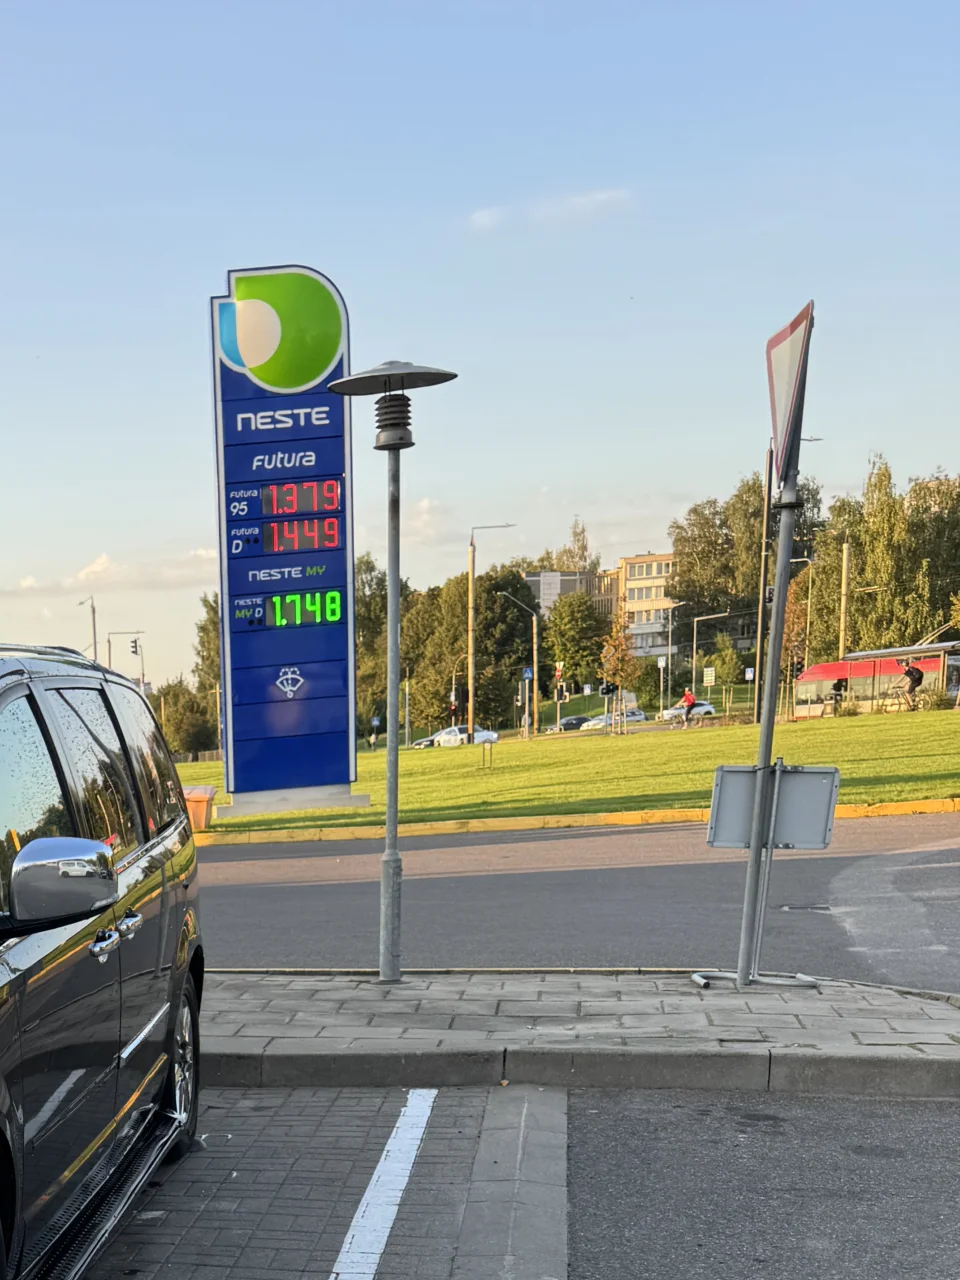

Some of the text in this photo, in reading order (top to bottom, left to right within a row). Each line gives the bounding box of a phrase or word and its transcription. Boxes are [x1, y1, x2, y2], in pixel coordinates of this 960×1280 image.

[236, 406, 330, 431] NESTE
[252, 451, 316, 470] Futura
[269, 480, 339, 515] 1.379
[229, 501, 248, 516] 95
[270, 517, 339, 552] 1.449
[231, 540, 243, 554] D
[248, 565, 326, 582] NESTE MY
[234, 590, 341, 626] NESTE 1.748
[235, 607, 263, 619] MY D
